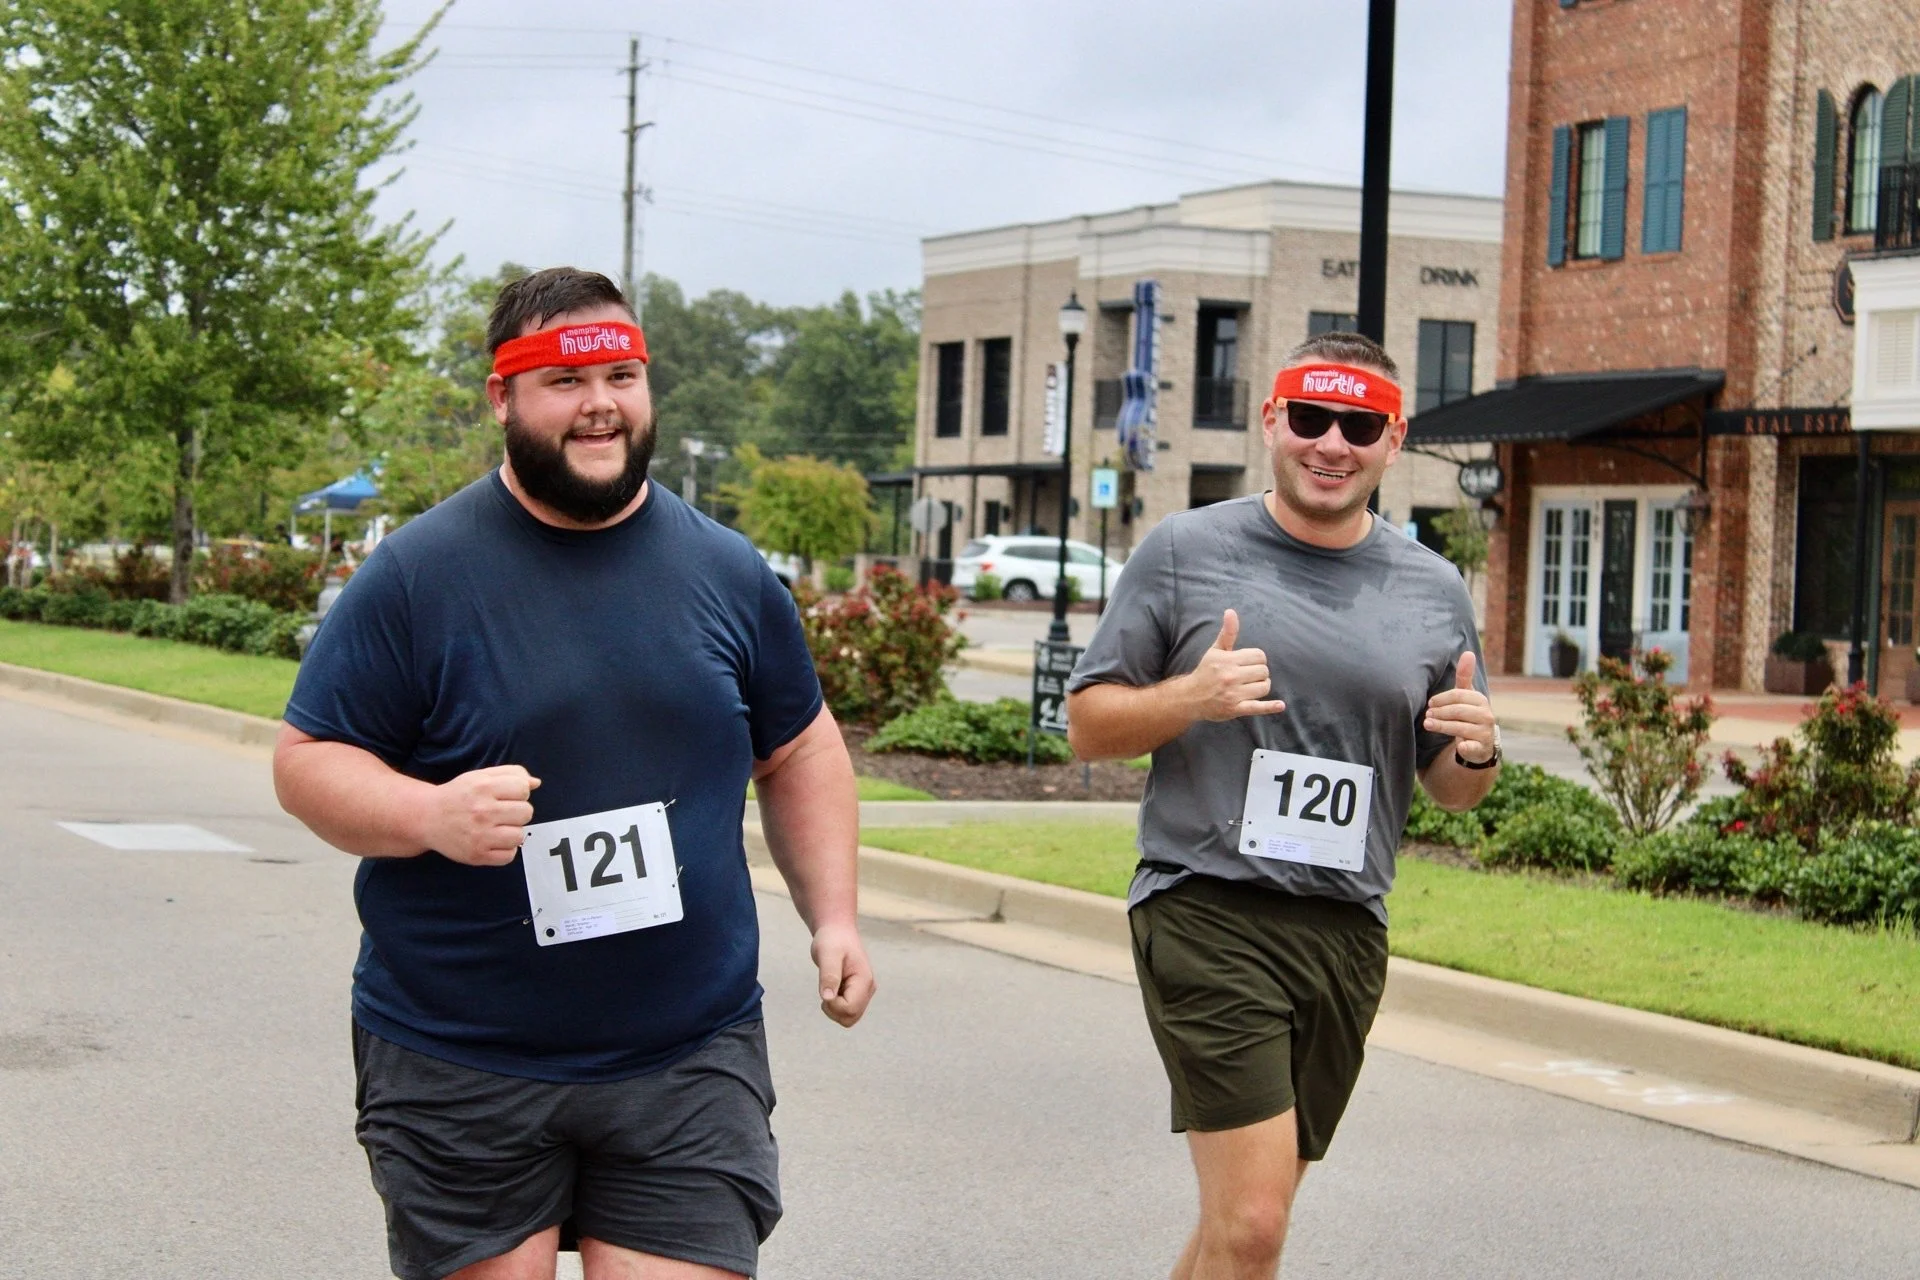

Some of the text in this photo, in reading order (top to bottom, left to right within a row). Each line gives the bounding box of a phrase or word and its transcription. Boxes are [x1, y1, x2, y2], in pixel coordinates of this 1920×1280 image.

[1321, 258, 1360, 278] EAT
[1420, 264, 1479, 288] DRINK
[560, 328, 632, 356] hustle
[567, 326, 600, 336] memphis
[1303, 372, 1367, 398] hustle
[1310, 369, 1339, 378] memphis
[1744, 415, 1793, 434] REAL
[1273, 769, 1357, 827] 120
[549, 824, 648, 893] 121
